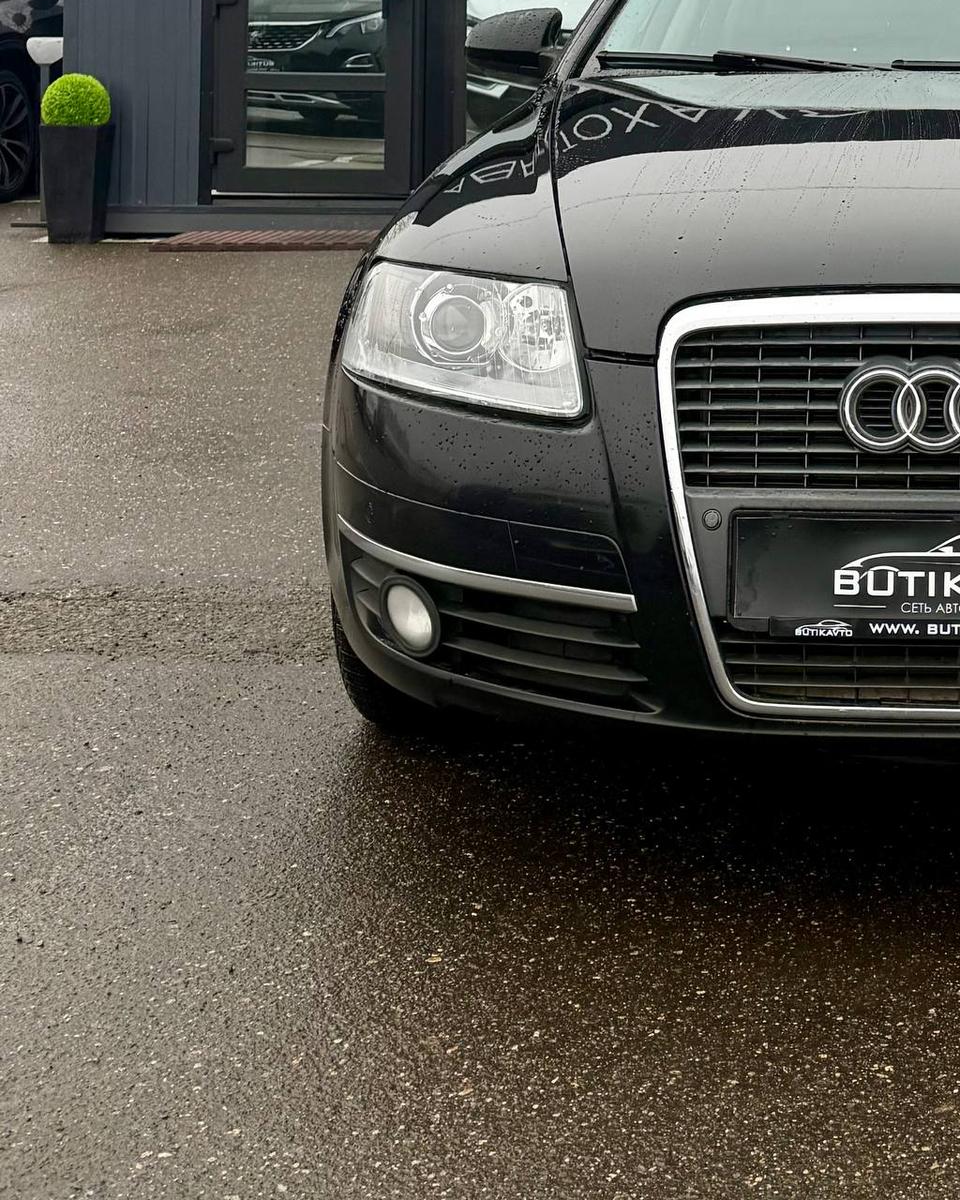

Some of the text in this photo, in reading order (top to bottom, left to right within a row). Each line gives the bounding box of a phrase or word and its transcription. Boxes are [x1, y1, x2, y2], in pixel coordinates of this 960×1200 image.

[901, 603, 932, 615] СЕТЬ
[794, 627, 853, 637] BUTIKAVTO
[869, 623, 920, 635] WWW.
